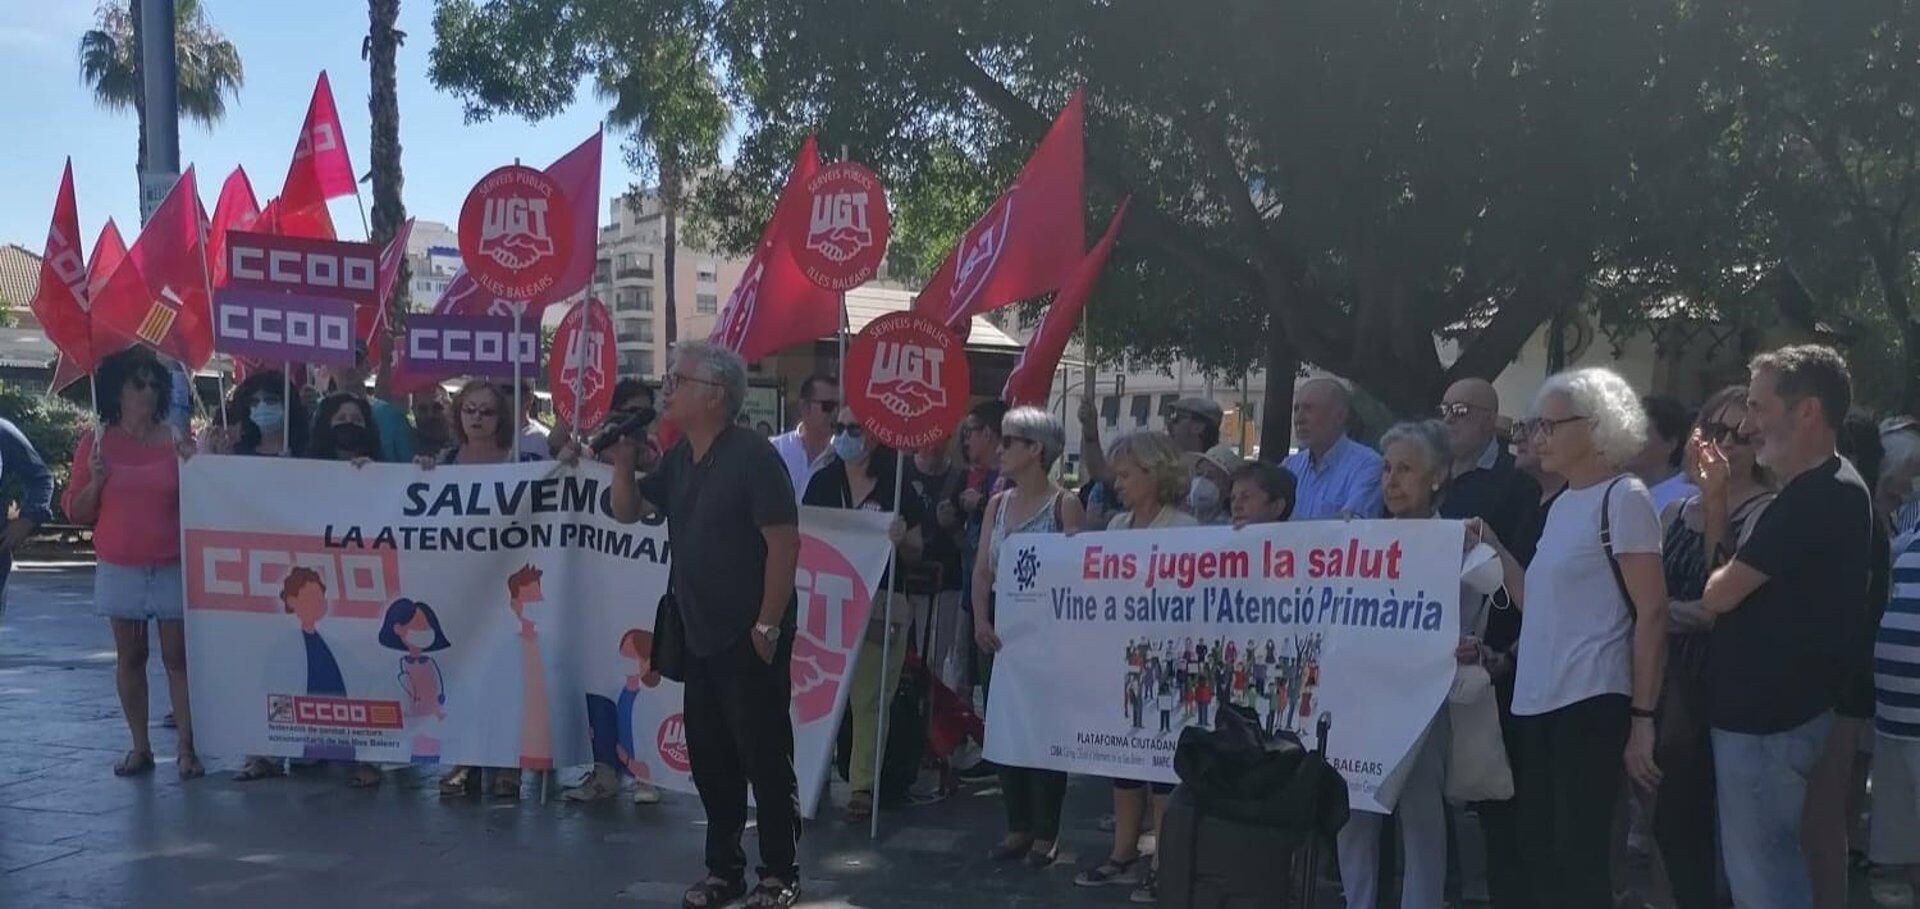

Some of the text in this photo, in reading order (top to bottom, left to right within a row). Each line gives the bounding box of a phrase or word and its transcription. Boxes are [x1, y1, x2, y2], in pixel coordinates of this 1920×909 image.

[480, 173, 514, 198] SERVEIS
[808, 169, 841, 193] SERVEIS
[481, 198, 549, 240] UGT
[811, 191, 869, 234] UGT
[232, 246, 376, 291] CCOO
[480, 271, 554, 298] ILLES BALEARS
[806, 265, 871, 290] ILLES BALEARS
[220, 303, 349, 351] CCOO
[870, 317, 911, 340] SERVEIS
[410, 328, 536, 363] CCOO
[564, 329, 605, 373] UGT
[871, 341, 944, 390] UGT
[864, 416, 943, 448] ILLES BALEARS
[324, 525, 365, 549] LA
[371, 520, 552, 552] ATENCIÓN
[202, 547, 388, 602] CCOO
[1082, 538, 1403, 588] Ens jugem la salut
[1051, 587, 1443, 631] Vine a salvar l'Atenció Primària
[299, 702, 368, 722] CCOO
[1077, 732, 1176, 751] PLATAFORMA CIUTADAN
[1333, 757, 1384, 777] BALEARS
